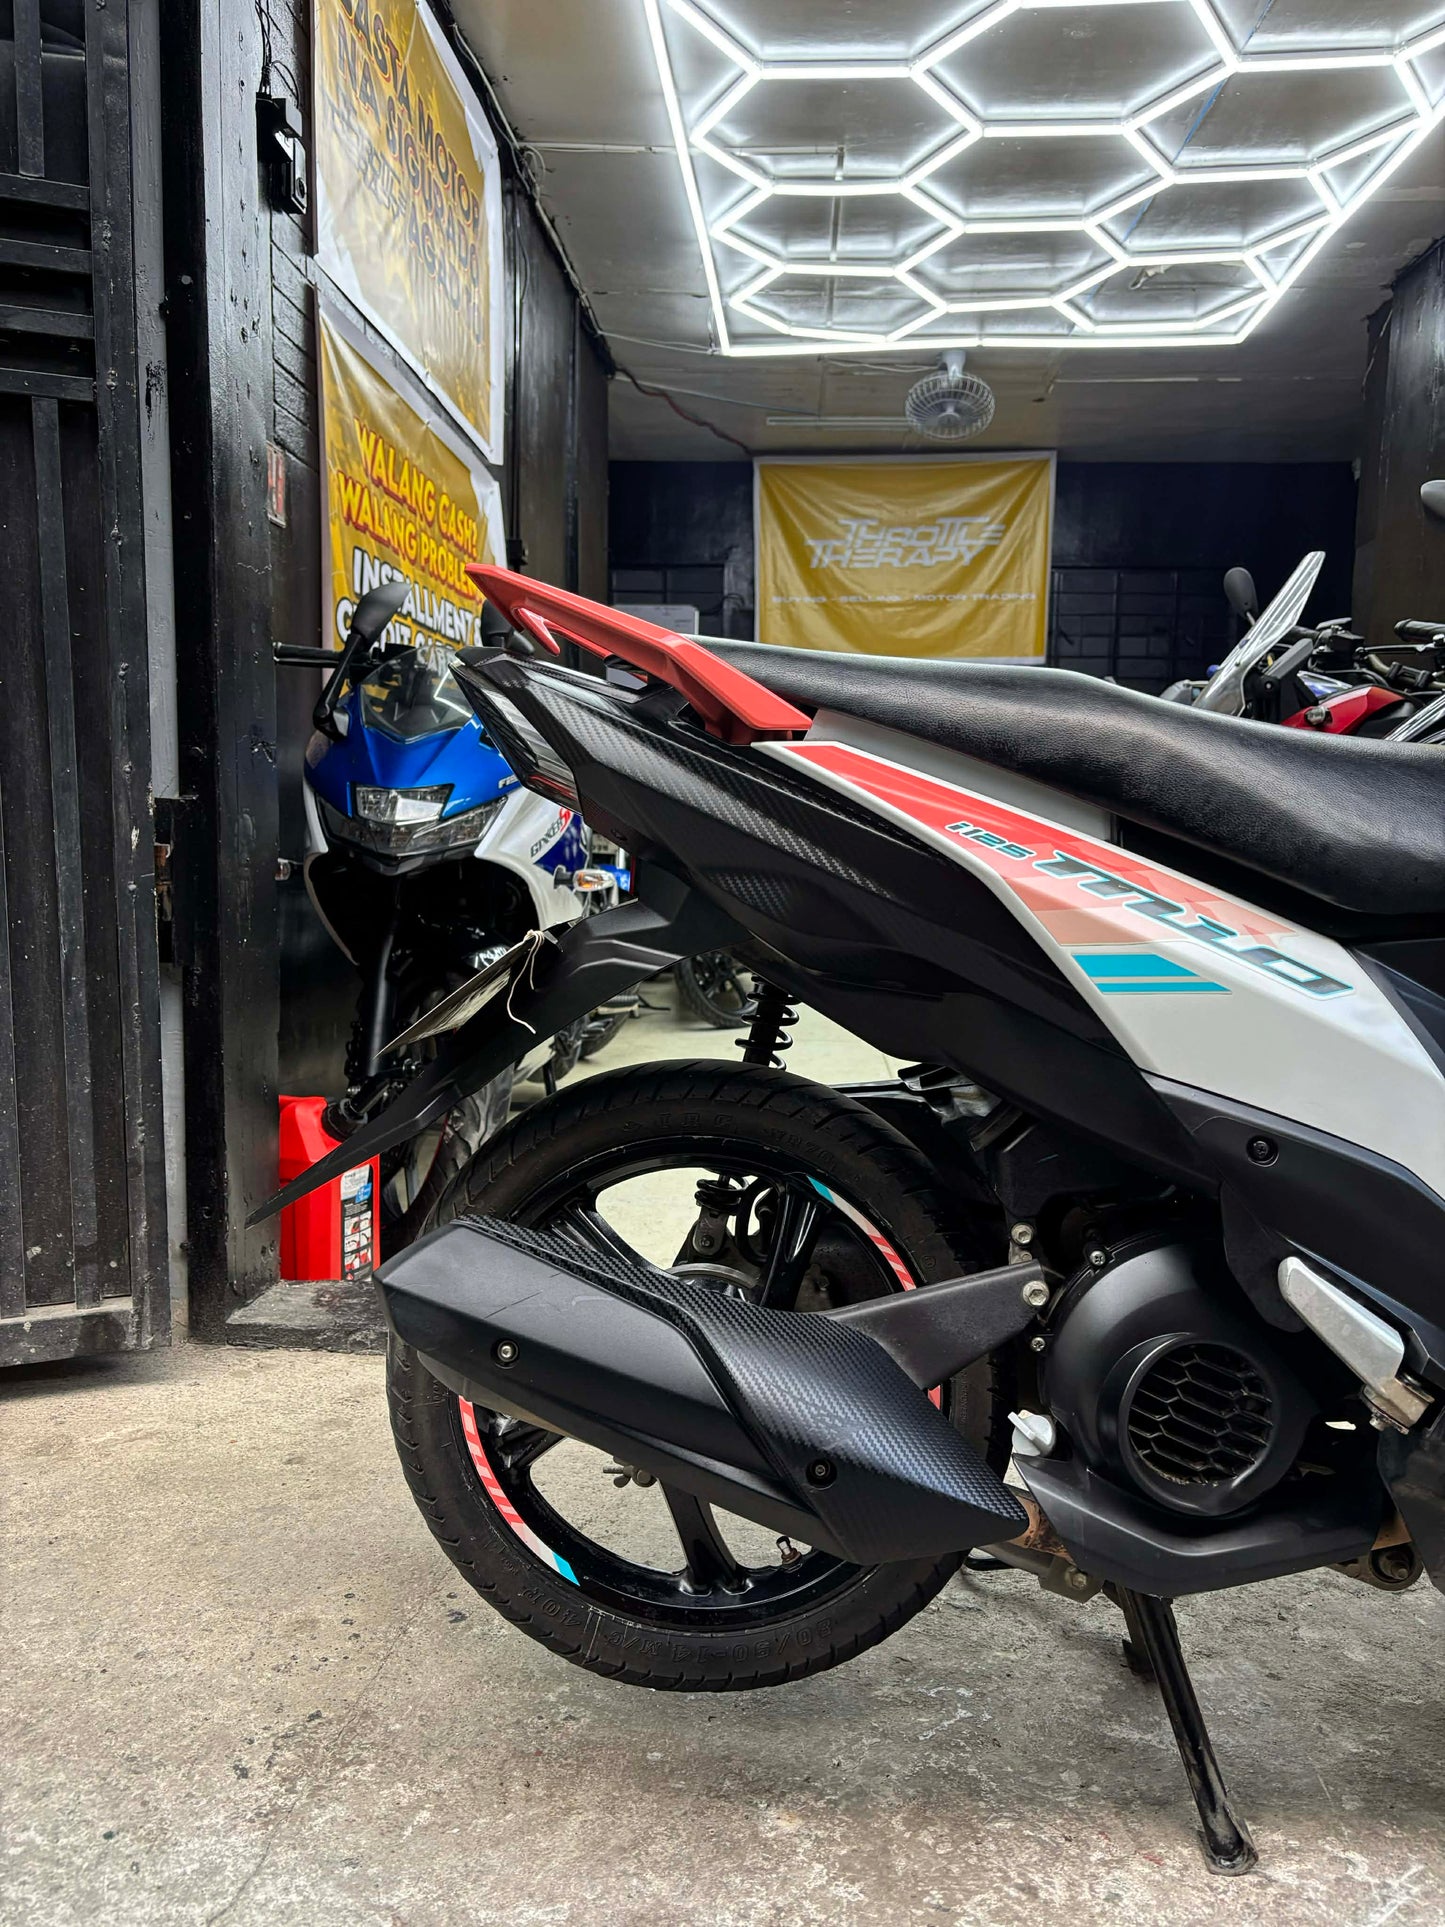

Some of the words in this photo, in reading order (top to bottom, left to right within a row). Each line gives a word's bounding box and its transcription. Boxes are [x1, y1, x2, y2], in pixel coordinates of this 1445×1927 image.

[341, 0, 412, 126] ASTA
[337, 470, 418, 566] WALANG
[355, 417, 436, 529] WALANG
[805, 539, 983, 568] THERAPY
[838, 516, 1005, 547] THROTTLE
[352, 545, 472, 646] INALLMENT
[914, 593, 967, 602] MOTOR
[973, 592, 1036, 601] TRADING
